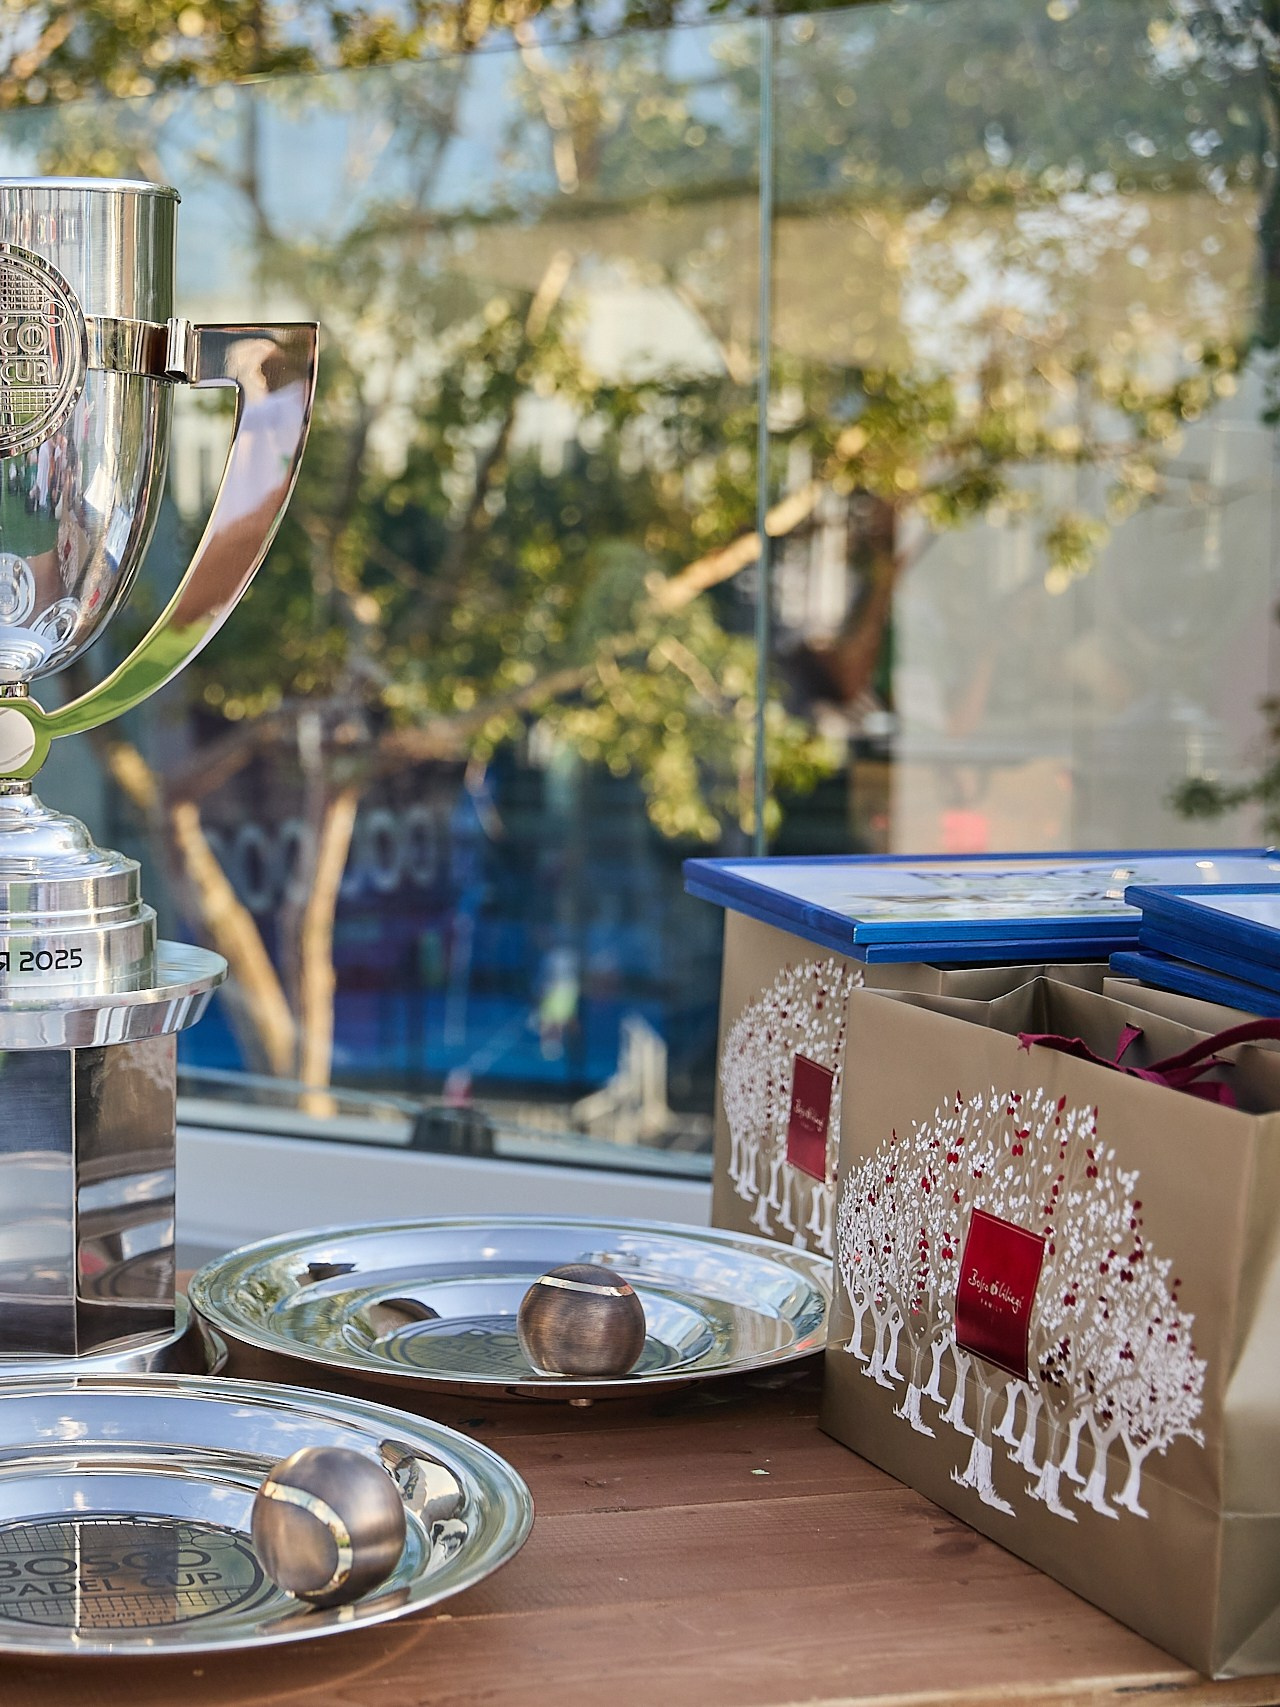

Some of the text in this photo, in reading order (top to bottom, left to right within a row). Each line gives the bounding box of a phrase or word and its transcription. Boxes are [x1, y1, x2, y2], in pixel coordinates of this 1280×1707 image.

[0, 360, 50, 385] CUP
[19, 948, 83, 972] 2025
[141, 1572, 223, 1589] CUP
